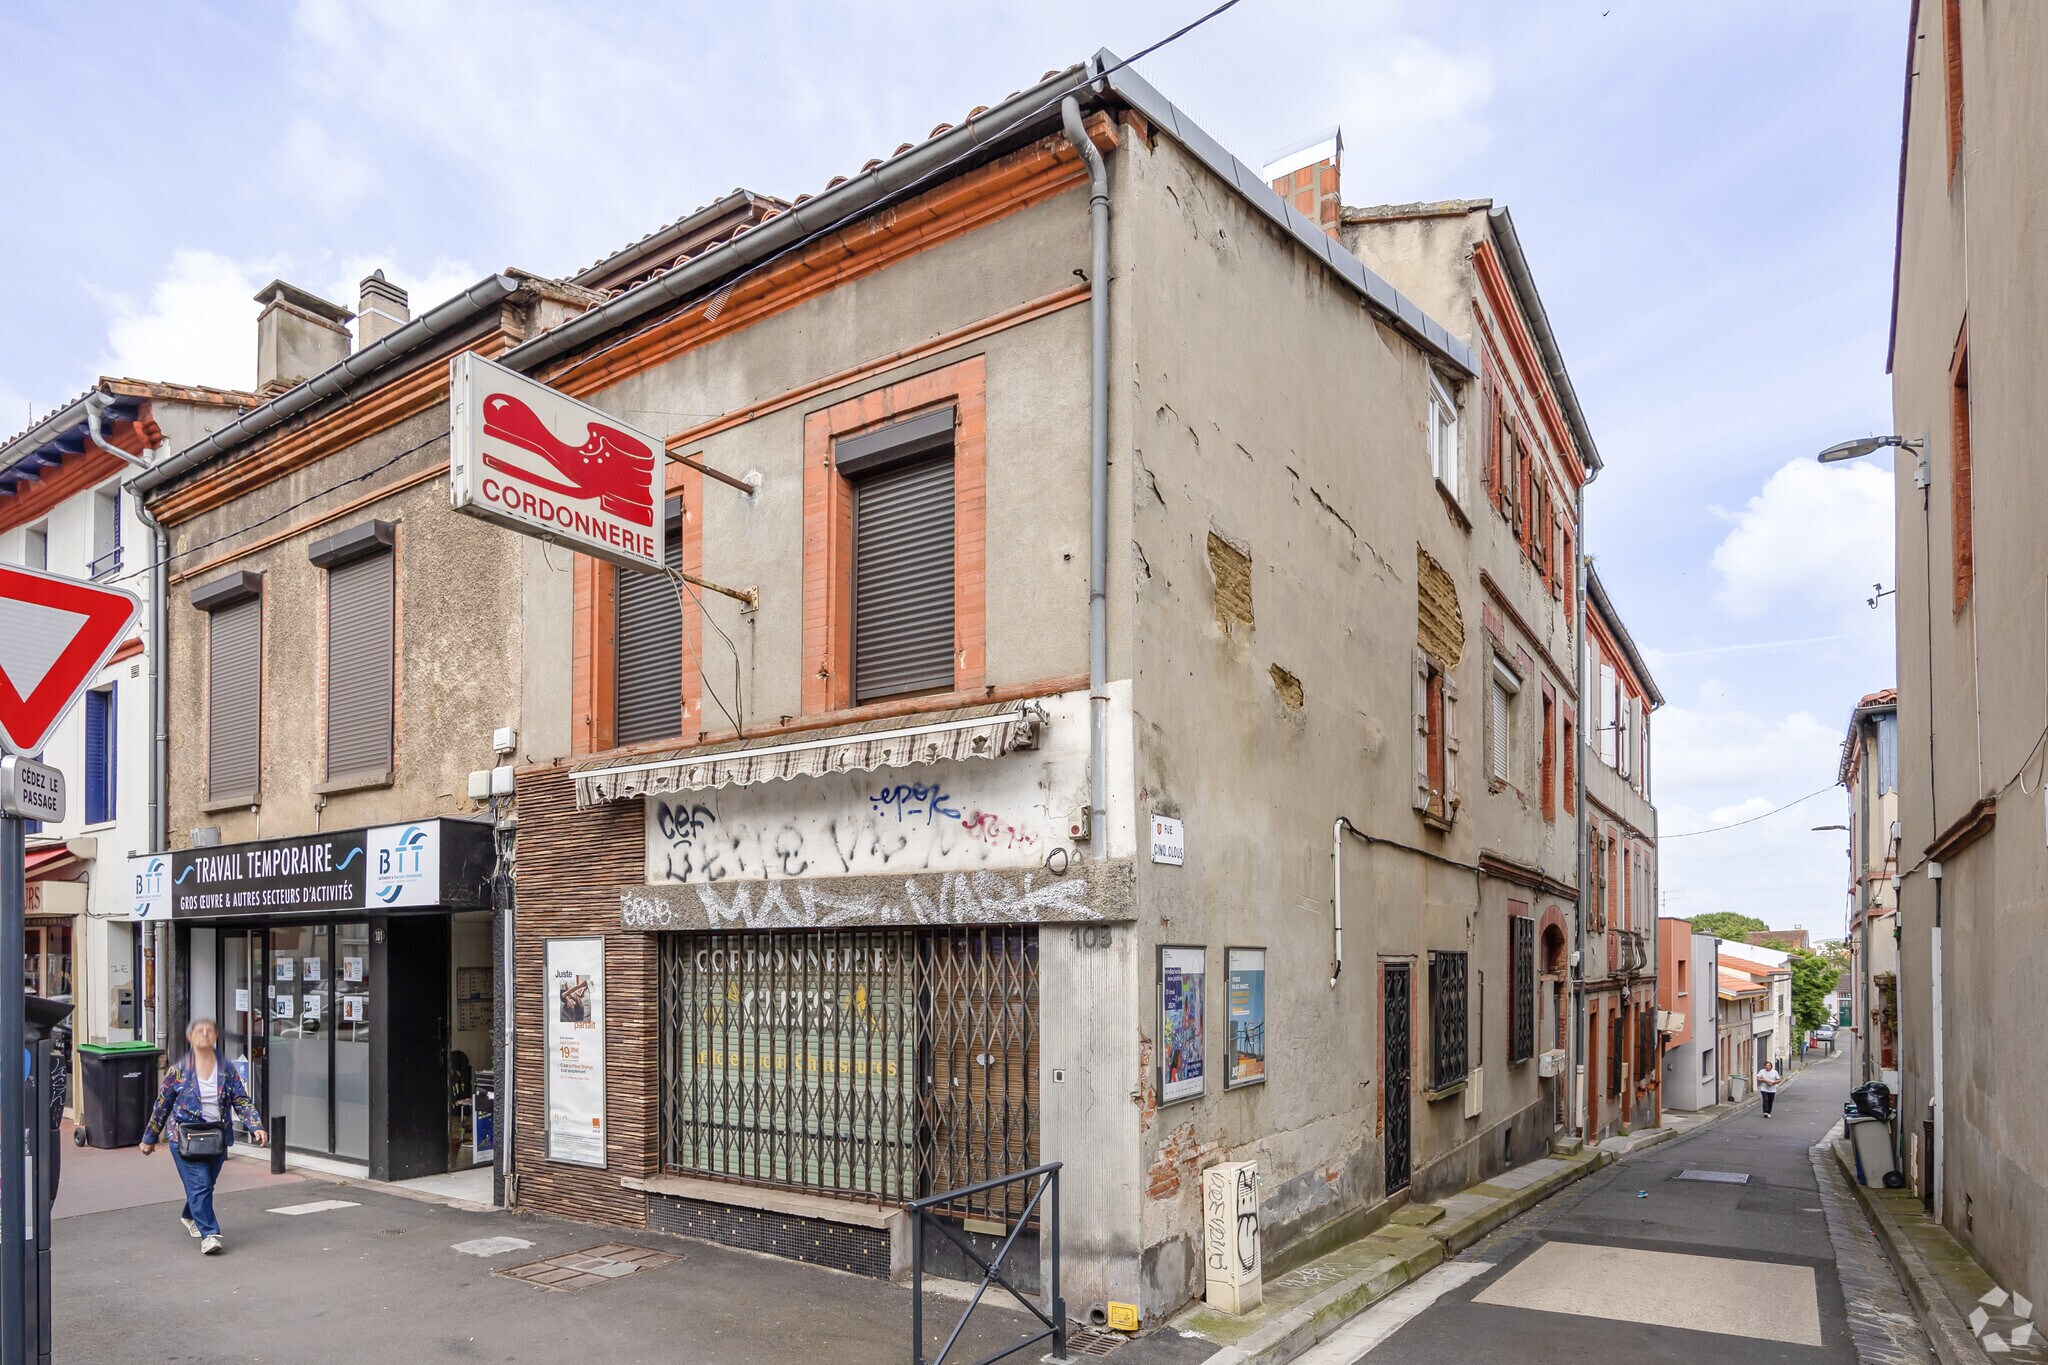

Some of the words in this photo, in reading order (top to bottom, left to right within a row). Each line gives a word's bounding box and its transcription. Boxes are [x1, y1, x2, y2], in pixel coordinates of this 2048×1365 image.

[482, 478, 654, 558] CORDONNERIE
[21, 767, 46, 788] CÉDEZ
[50, 777, 58, 793] LE
[23, 789, 57, 811] PASSAGE
[1164, 824, 1173, 835] RUE
[195, 853, 243, 883] TRAVAIL
[247, 843, 332, 878] TEMPORAIRE
[180, 895, 198, 910] GROS
[199, 893, 223, 909] ŒUVRE
[225, 893, 231, 908] &
[233, 890, 260, 907] AUTRES
[262, 887, 300, 906] SECTEURS
[303, 879, 353, 903] D'ACTIVITÉS
[1070, 925, 1112, 951] 103
[555, 970, 573, 978] Juste
[574, 1021, 596, 1030] parfait
[795, 1049, 897, 1076] Chusures
